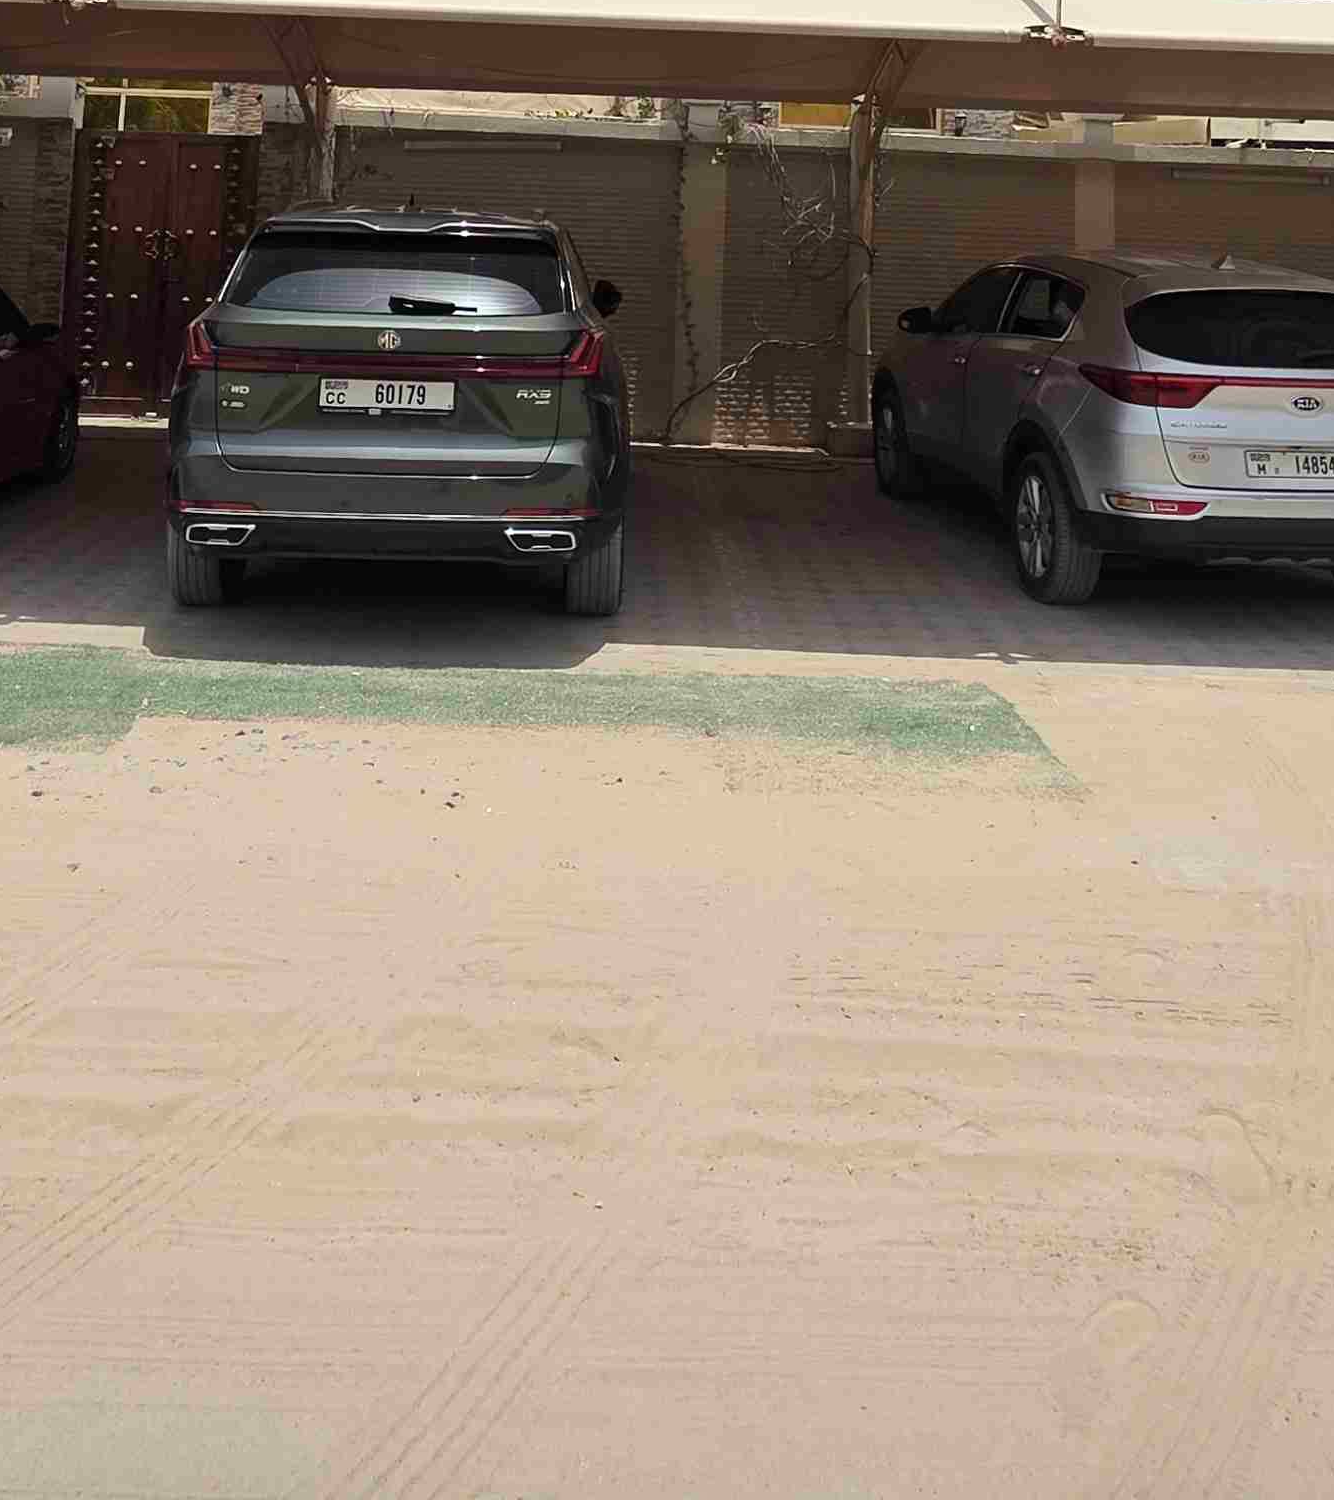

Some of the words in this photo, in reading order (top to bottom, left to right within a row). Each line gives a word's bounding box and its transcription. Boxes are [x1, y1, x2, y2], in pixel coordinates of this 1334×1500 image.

[378, 330, 402, 349] MG
[325, 391, 348, 405] CC
[375, 383, 427, 406] 60179
[1296, 397, 1320, 410] KIA
